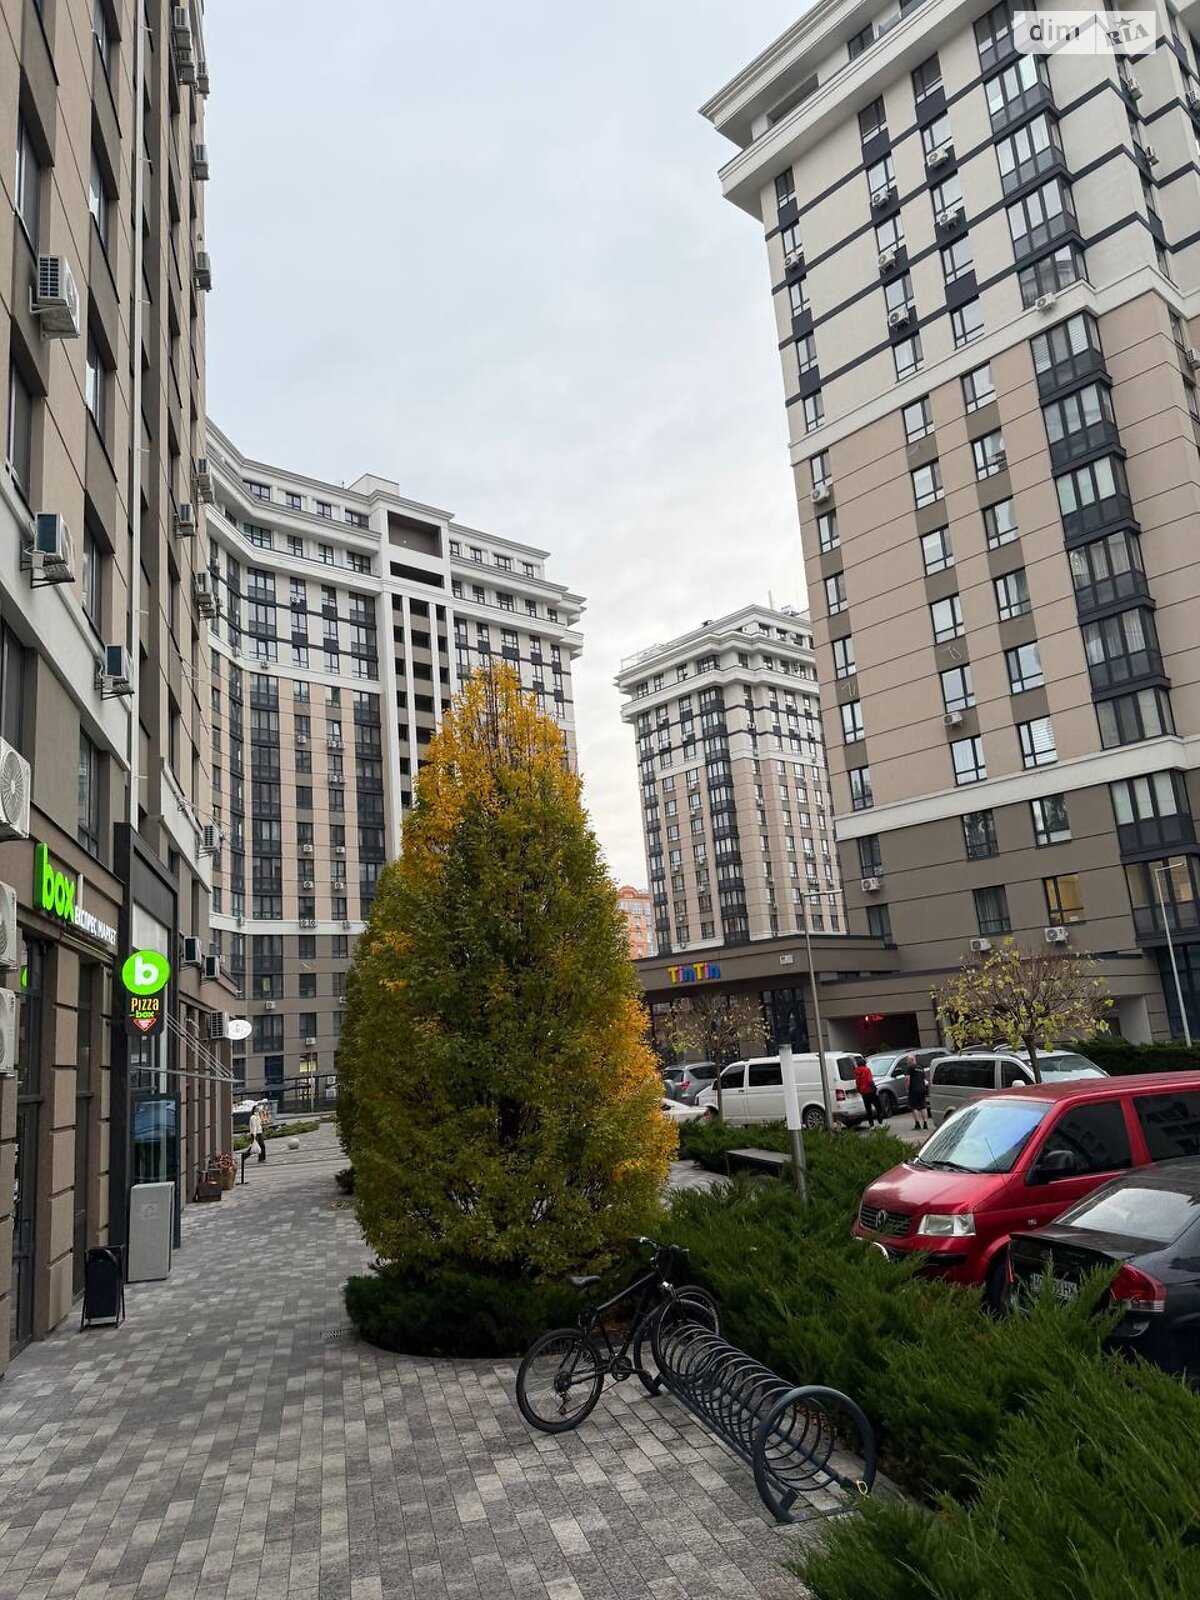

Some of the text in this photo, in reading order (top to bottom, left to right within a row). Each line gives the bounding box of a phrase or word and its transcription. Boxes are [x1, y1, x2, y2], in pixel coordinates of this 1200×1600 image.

[37, 842, 75, 923] box
[134, 955, 159, 986] b
[667, 961, 721, 984] TinTin
[135, 1010, 155, 1019] box
